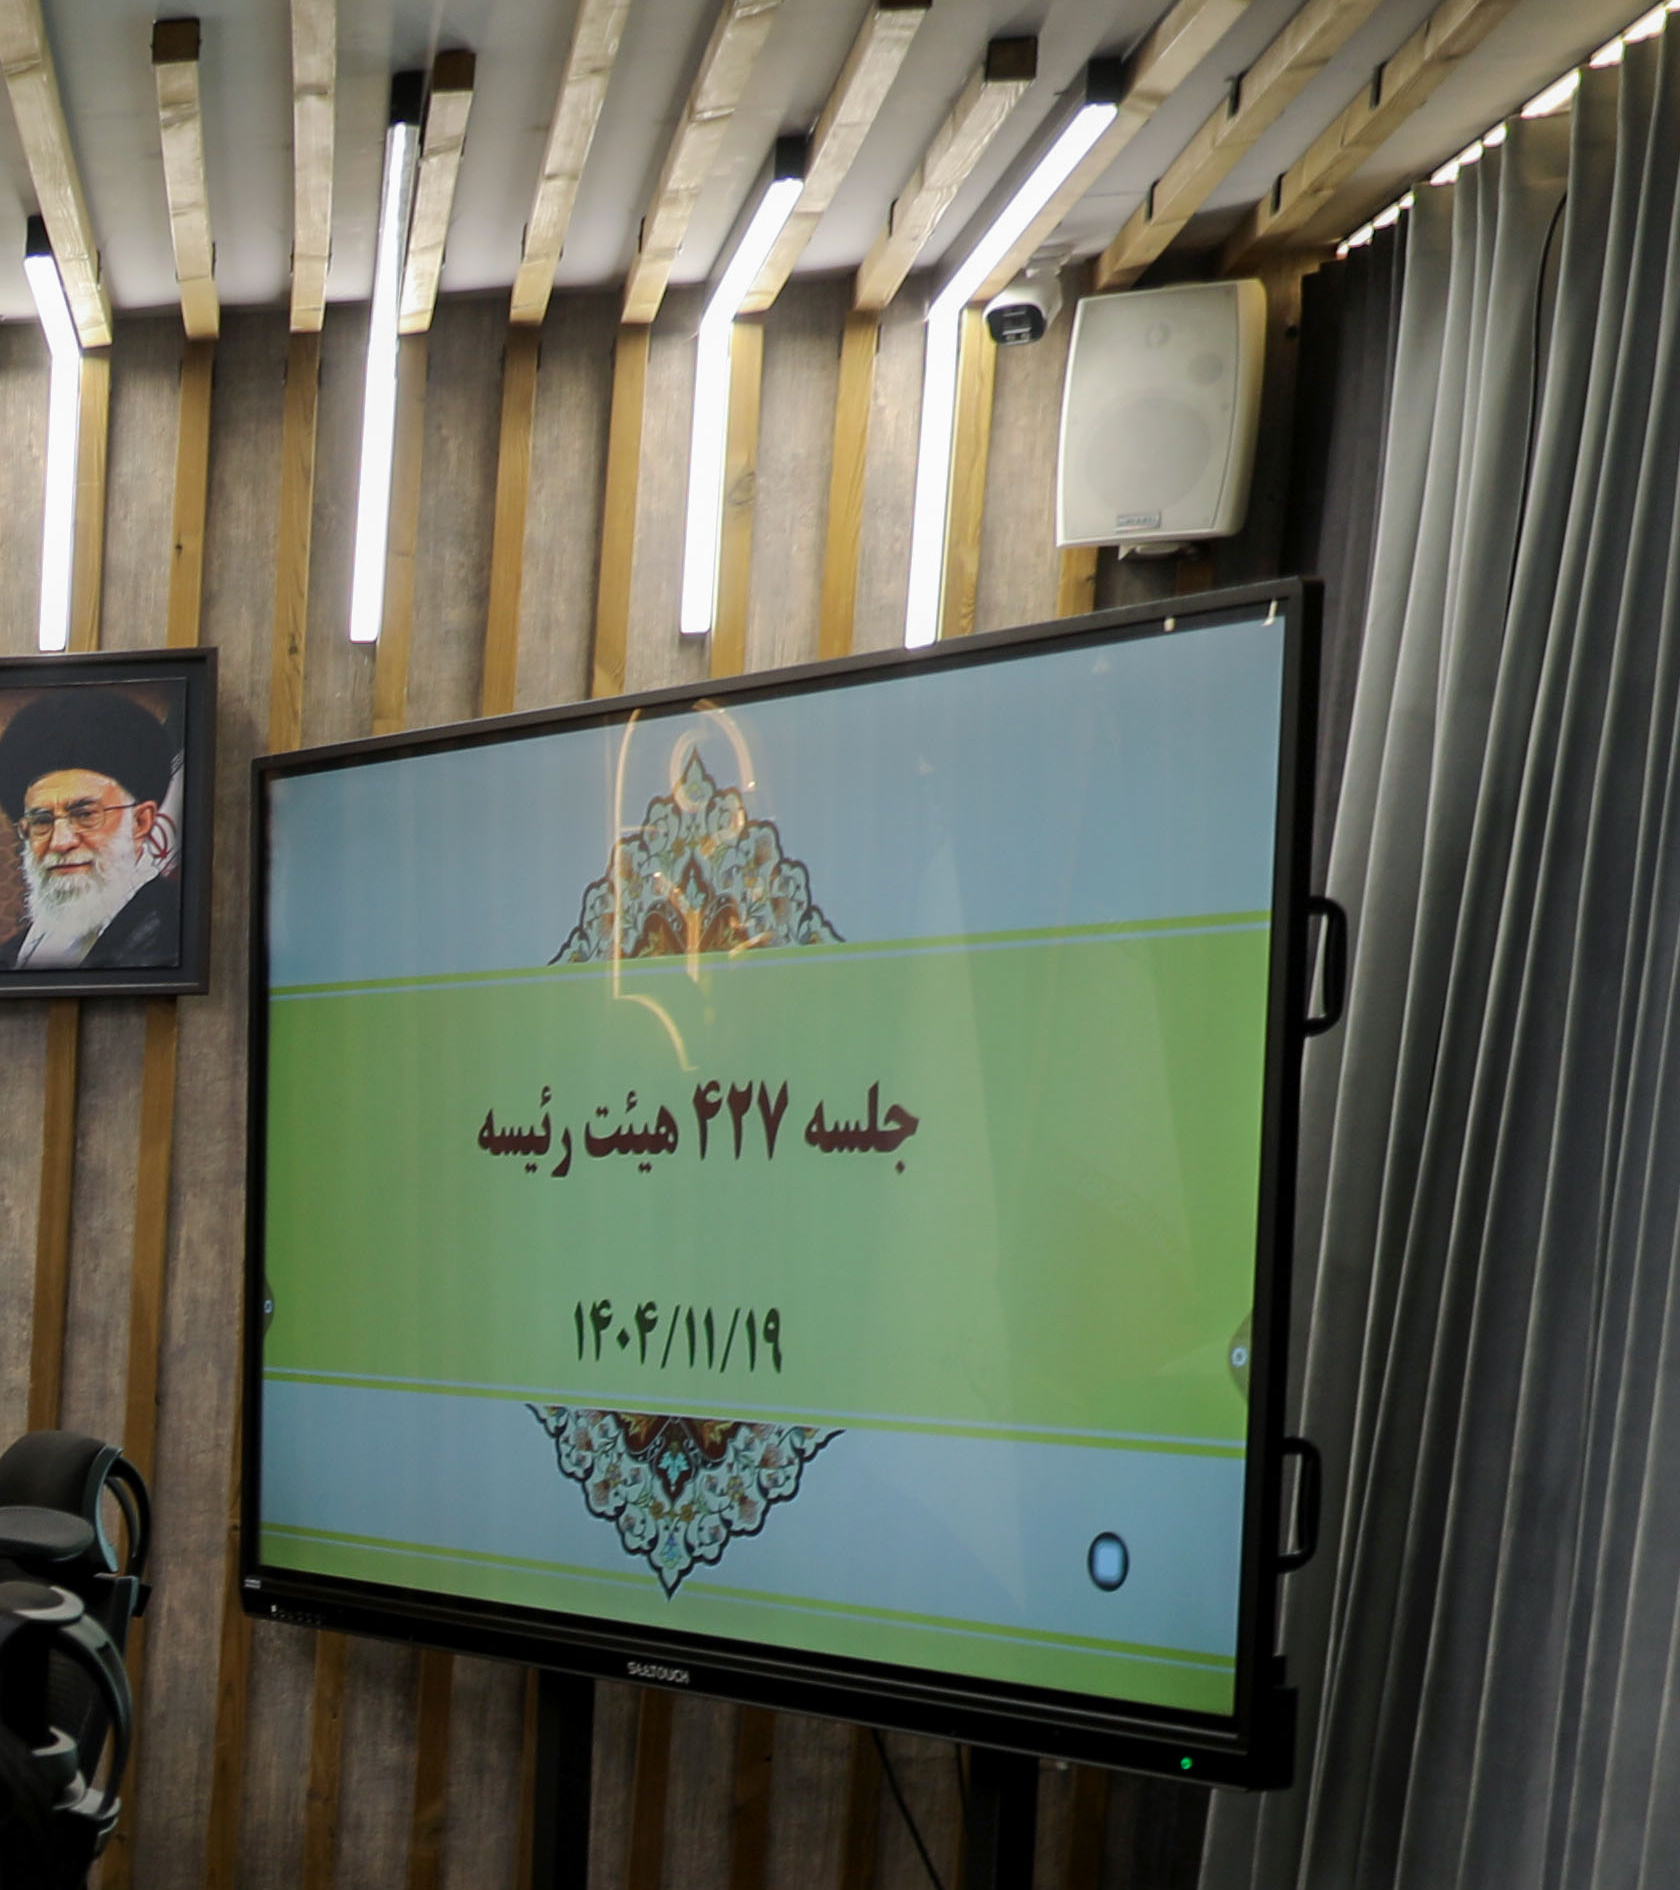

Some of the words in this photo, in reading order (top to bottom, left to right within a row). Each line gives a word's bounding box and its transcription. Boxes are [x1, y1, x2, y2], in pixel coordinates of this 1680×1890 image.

[477, 1085, 573, 1177] رئیسه
[584, 1090, 679, 1174] هیئت
[692, 1079, 789, 1161] ۴۲۷
[803, 1079, 920, 1175] جلسه
[574, 1299, 783, 1374] ۱۴۰۴/۱۱/۱۹
